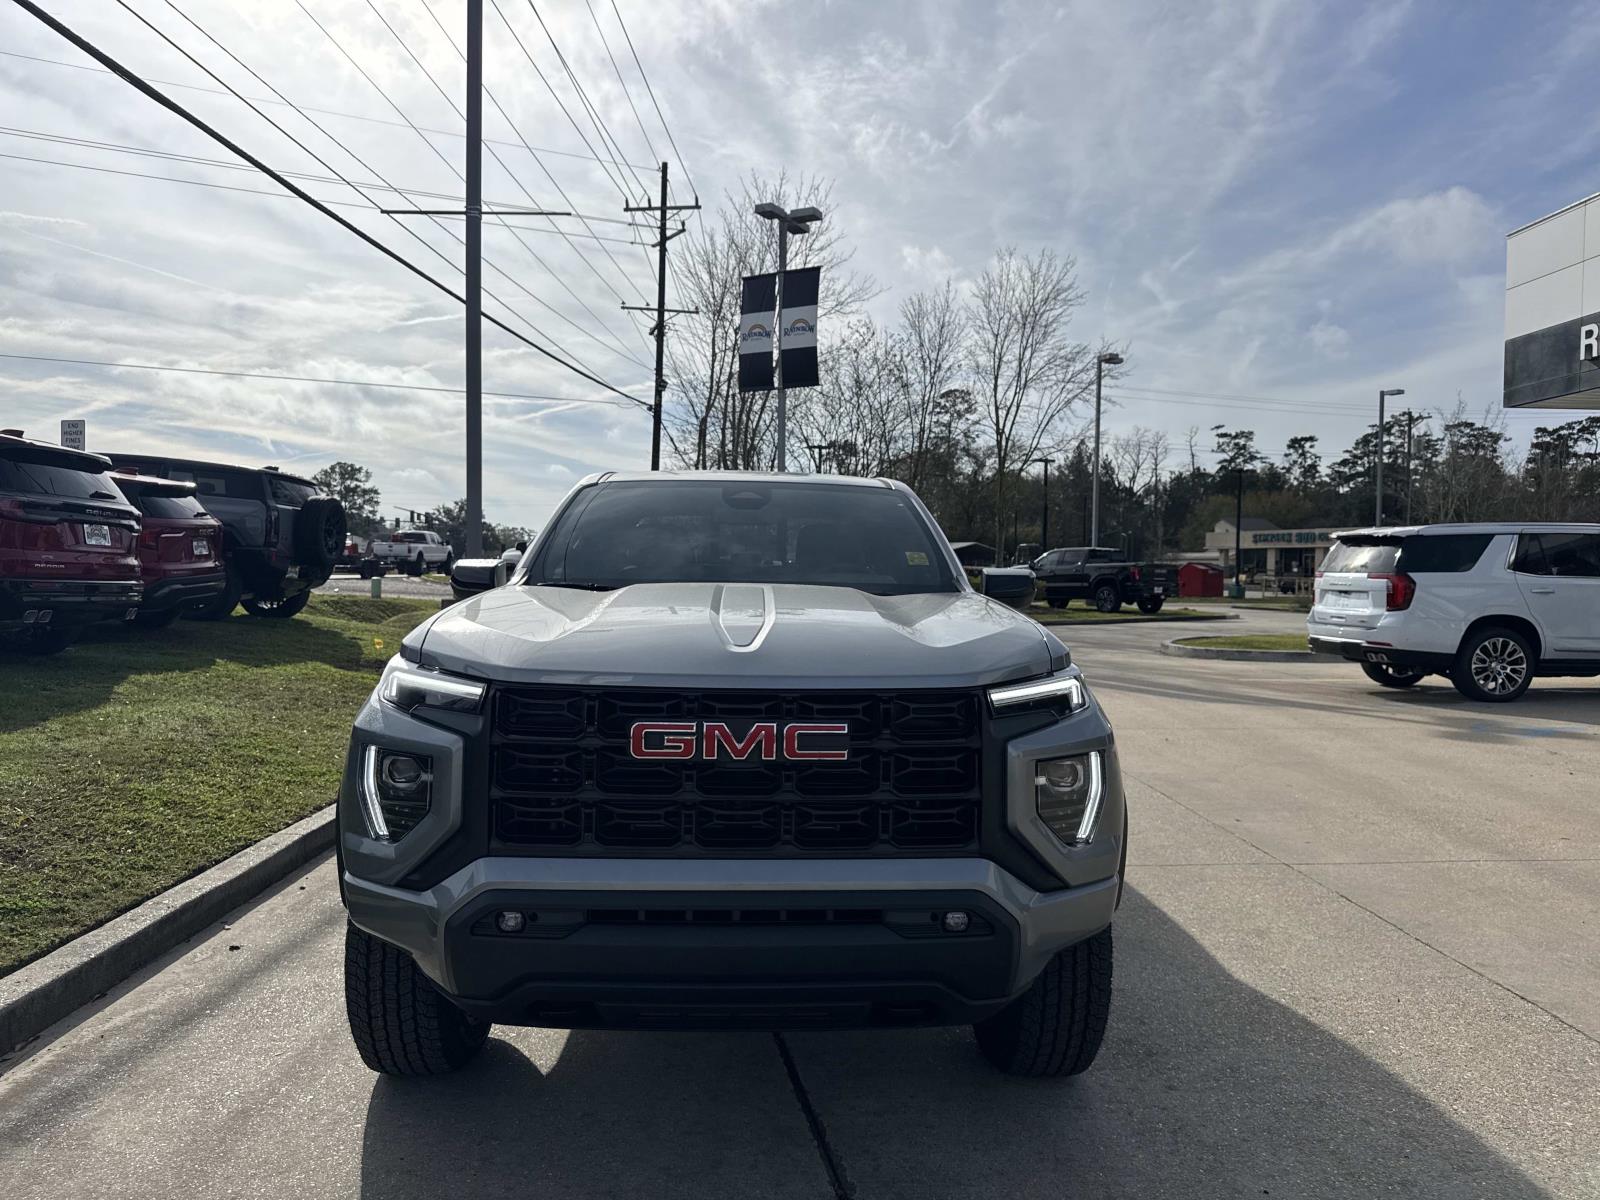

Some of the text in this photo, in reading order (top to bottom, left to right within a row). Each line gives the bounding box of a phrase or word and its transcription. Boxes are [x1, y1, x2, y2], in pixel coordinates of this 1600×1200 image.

[742, 329, 772, 342] RAINBOW
[783, 324, 815, 337] RAINBOW
[630, 721, 849, 761] GMC
